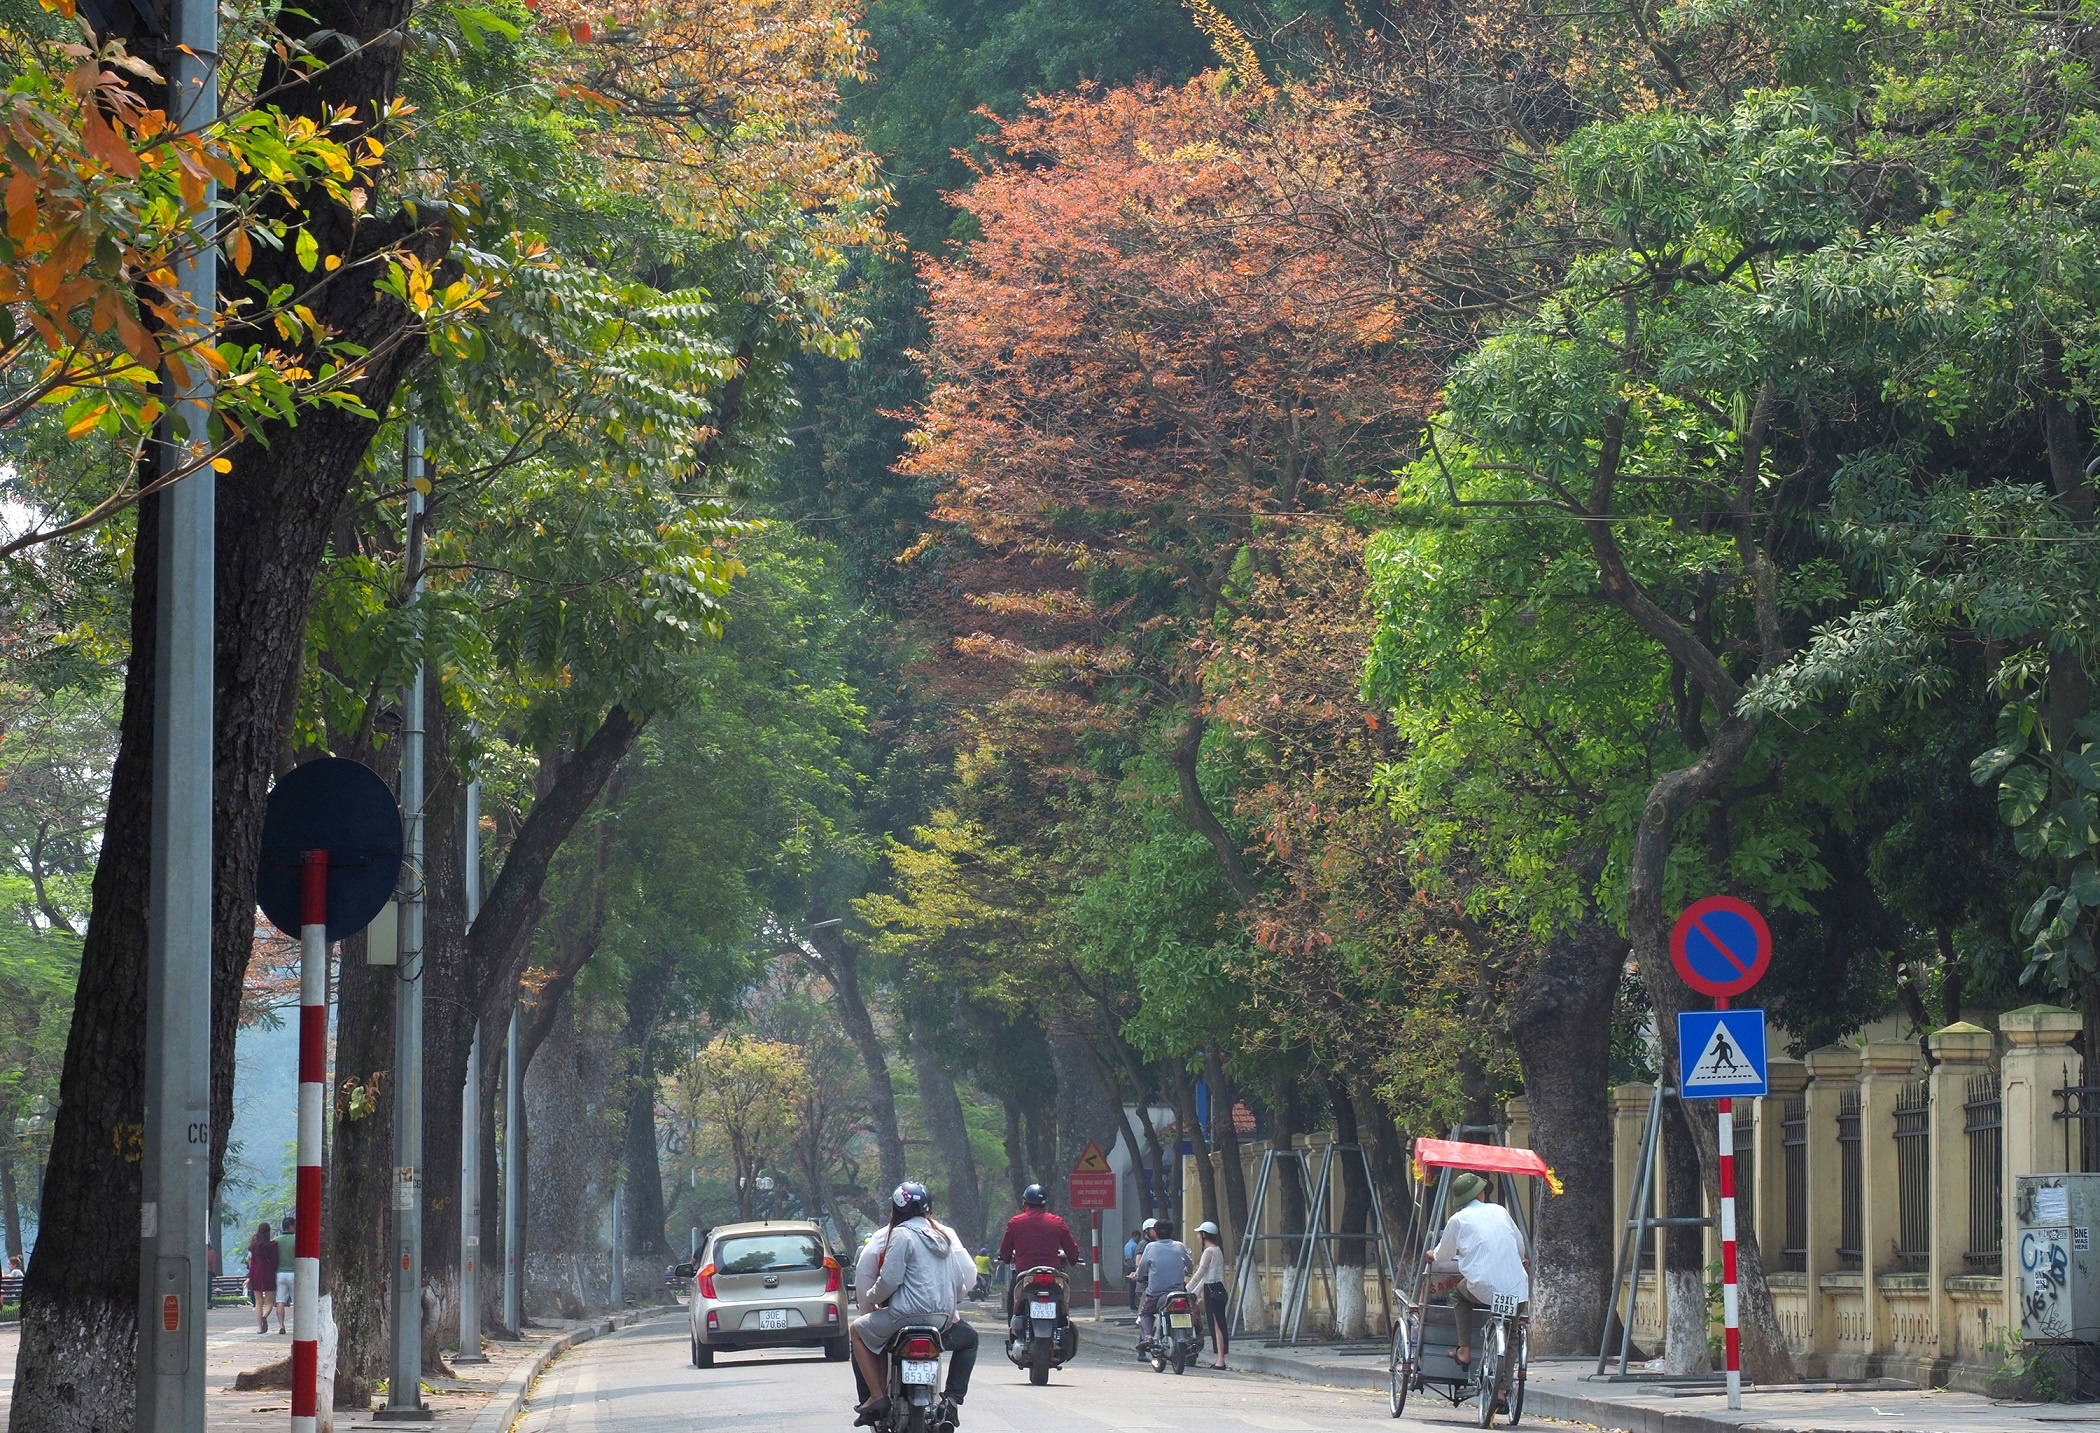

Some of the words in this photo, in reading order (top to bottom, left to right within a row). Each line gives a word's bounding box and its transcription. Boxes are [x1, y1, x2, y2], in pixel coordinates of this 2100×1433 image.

[188, 1123, 208, 1144] CG
[2074, 1229, 2088, 1239] BNE
[1494, 1293, 1514, 1306] 29XL
[1493, 1304, 1514, 1315] 0083
[765, 1311, 780, 1320] 30E
[907, 1361, 933, 1372] 29-E1
[904, 1371, 936, 1384] 853.92
